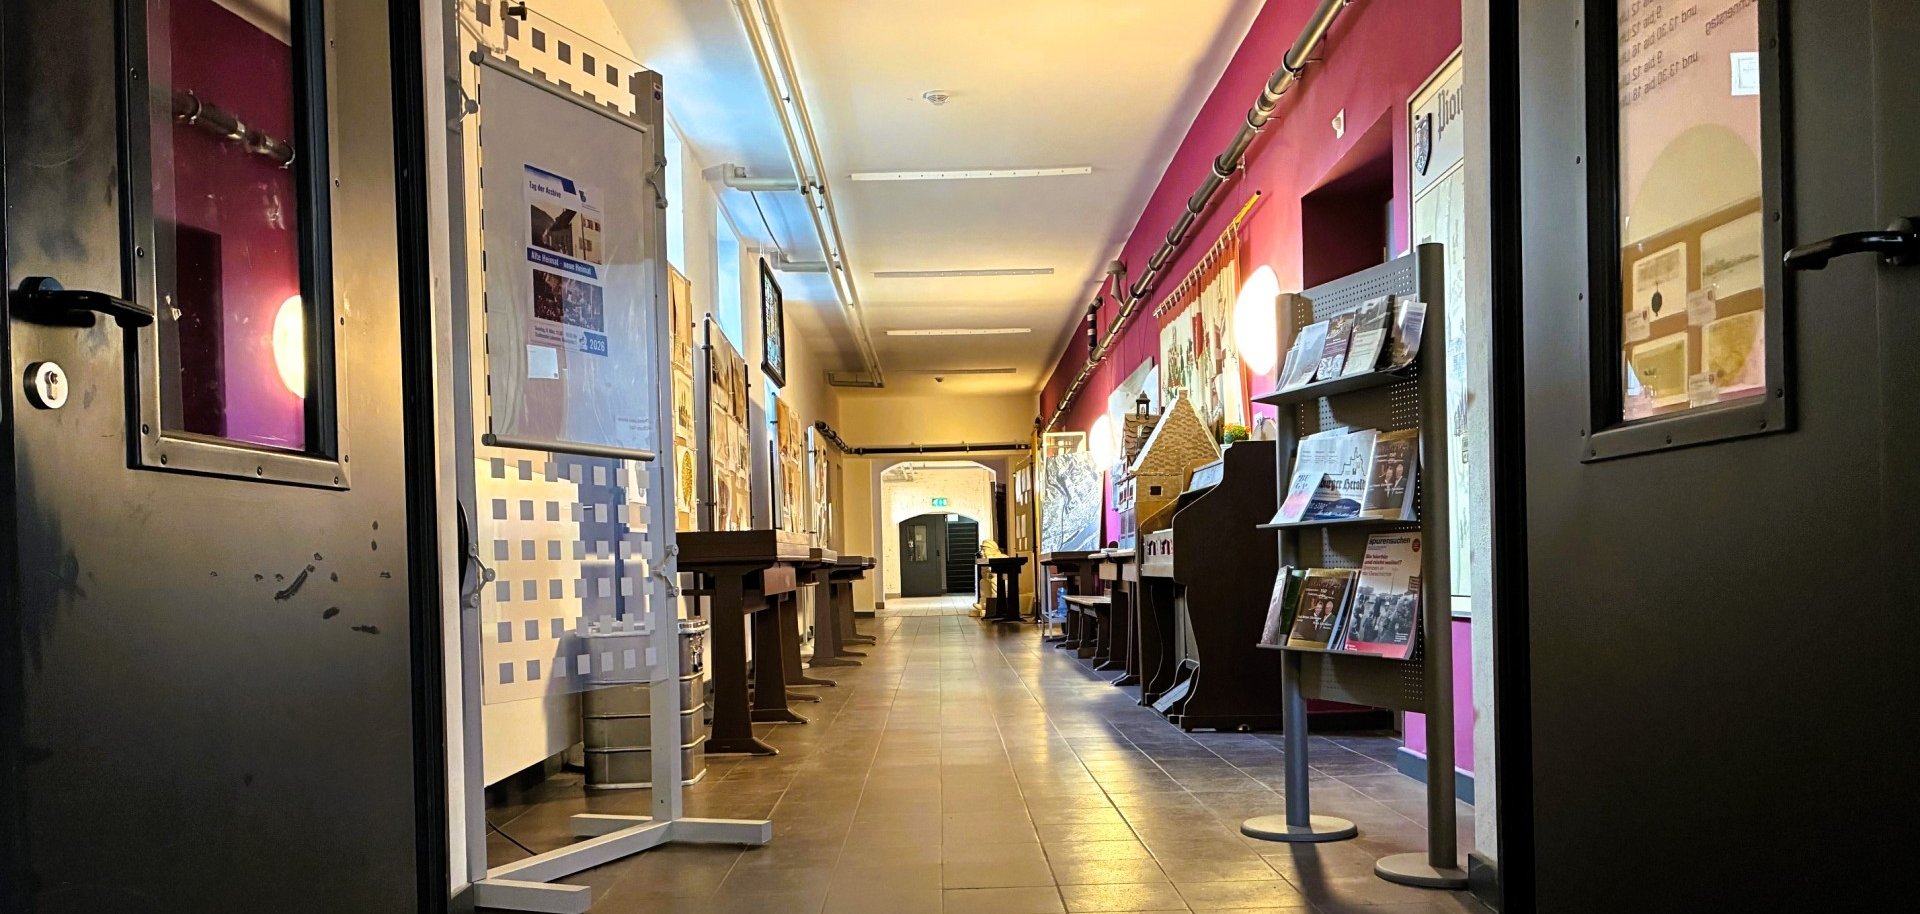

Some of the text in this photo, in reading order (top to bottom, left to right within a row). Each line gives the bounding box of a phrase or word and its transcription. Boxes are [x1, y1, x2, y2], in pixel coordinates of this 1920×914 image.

[529, 180, 562, 199] Tag der Archive
[531, 250, 541, 261] Alte
[541, 254, 559, 266] Heimat
[563, 261, 575, 270] neue
[575, 263, 592, 275] Heimat
[589, 338, 605, 352] 2026
[1369, 537, 1410, 545] spurensuchen
